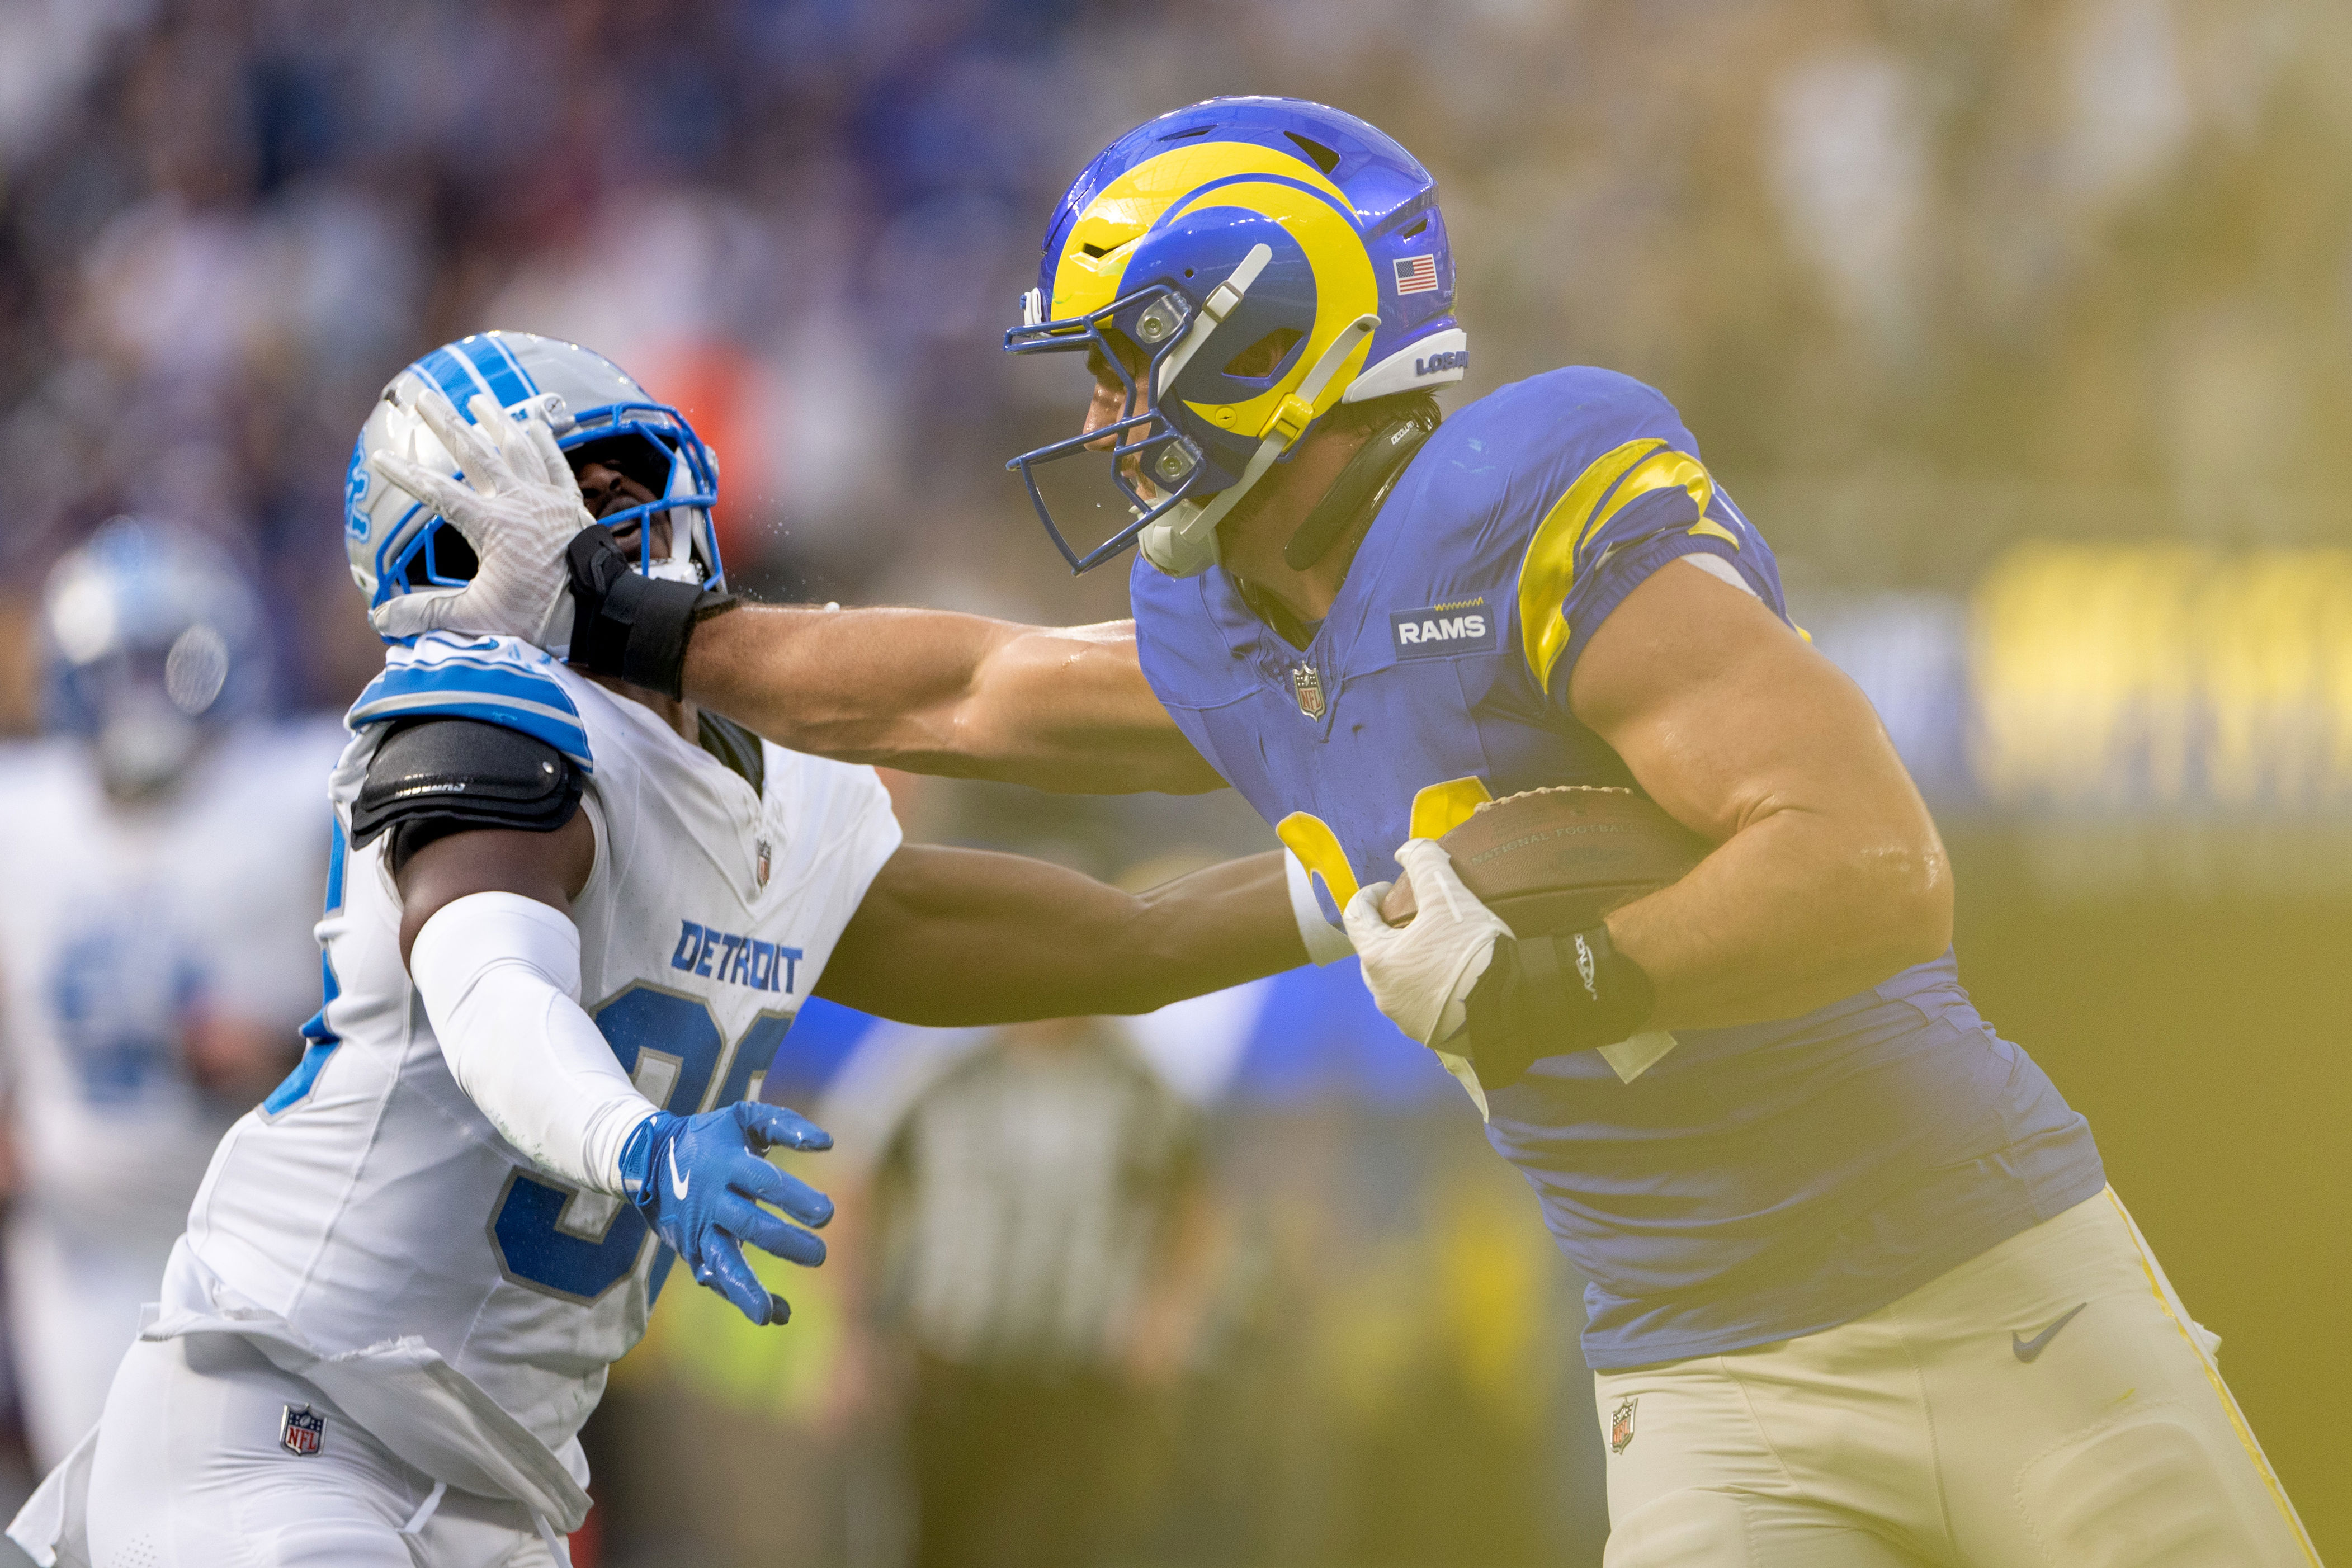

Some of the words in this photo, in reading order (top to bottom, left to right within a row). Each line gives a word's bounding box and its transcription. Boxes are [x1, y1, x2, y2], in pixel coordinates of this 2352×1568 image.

[1399, 615, 1486, 644] RAMS
[1300, 689, 1321, 711] NFL
[1471, 832, 1550, 866] NATIONAL
[670, 919, 804, 994] DETROIT
[287, 1425, 317, 1451] NFL
